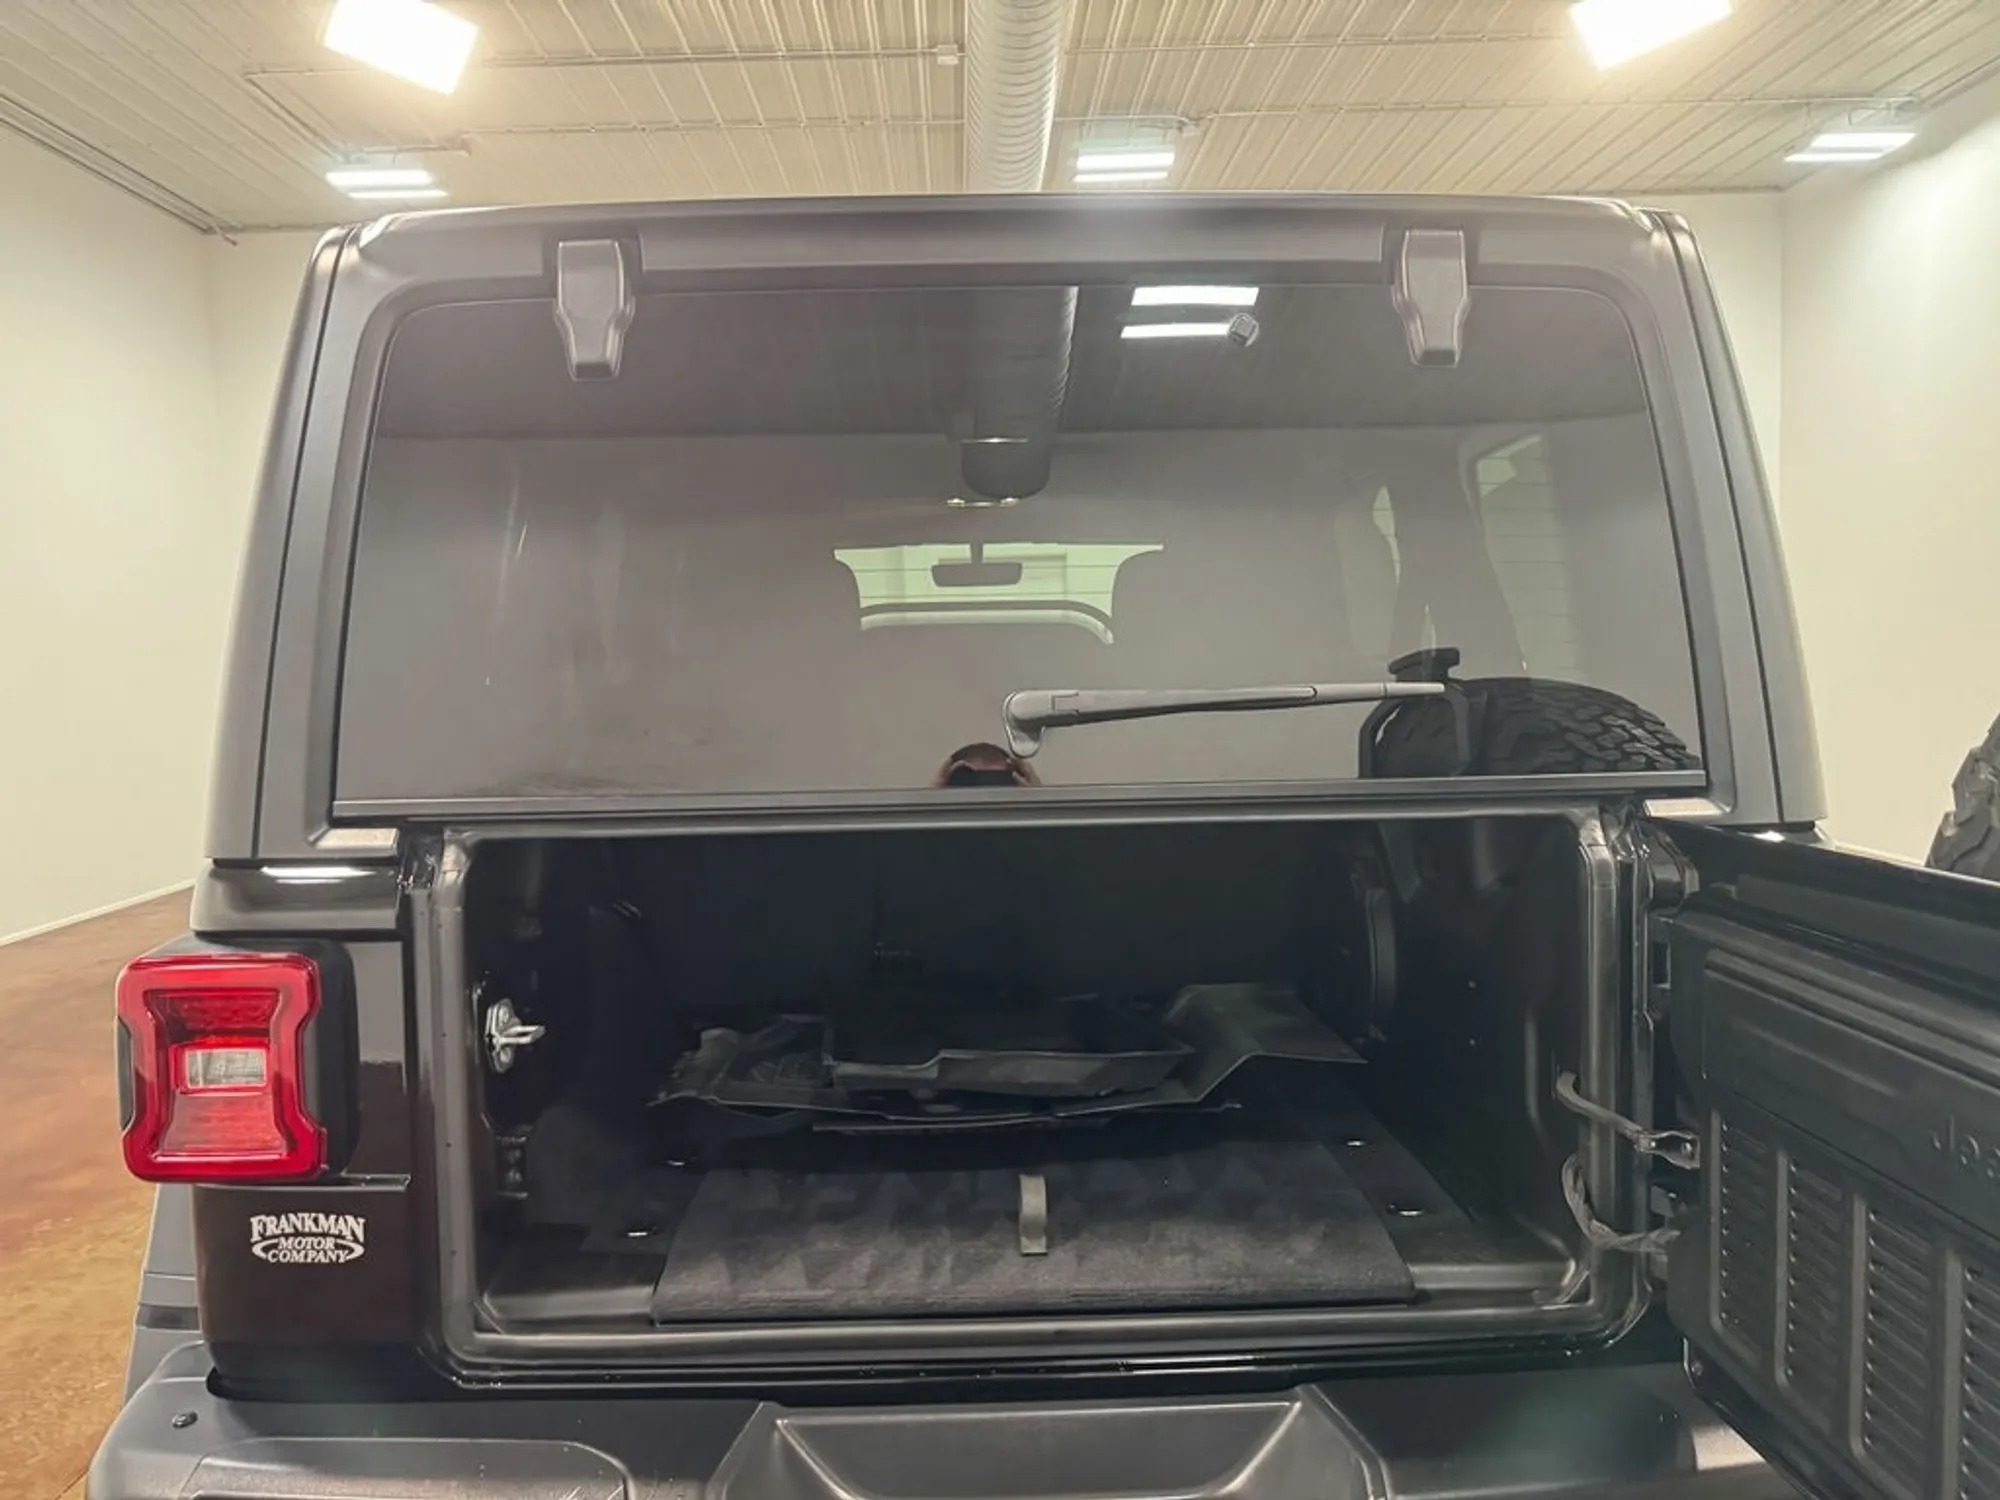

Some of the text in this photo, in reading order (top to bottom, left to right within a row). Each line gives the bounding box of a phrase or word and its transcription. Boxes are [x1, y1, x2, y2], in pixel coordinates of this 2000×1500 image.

[250, 1212, 366, 1243] FRANKMAN
[278, 1236, 336, 1250] MOTOR
[267, 1249, 349, 1263] COMPANY
